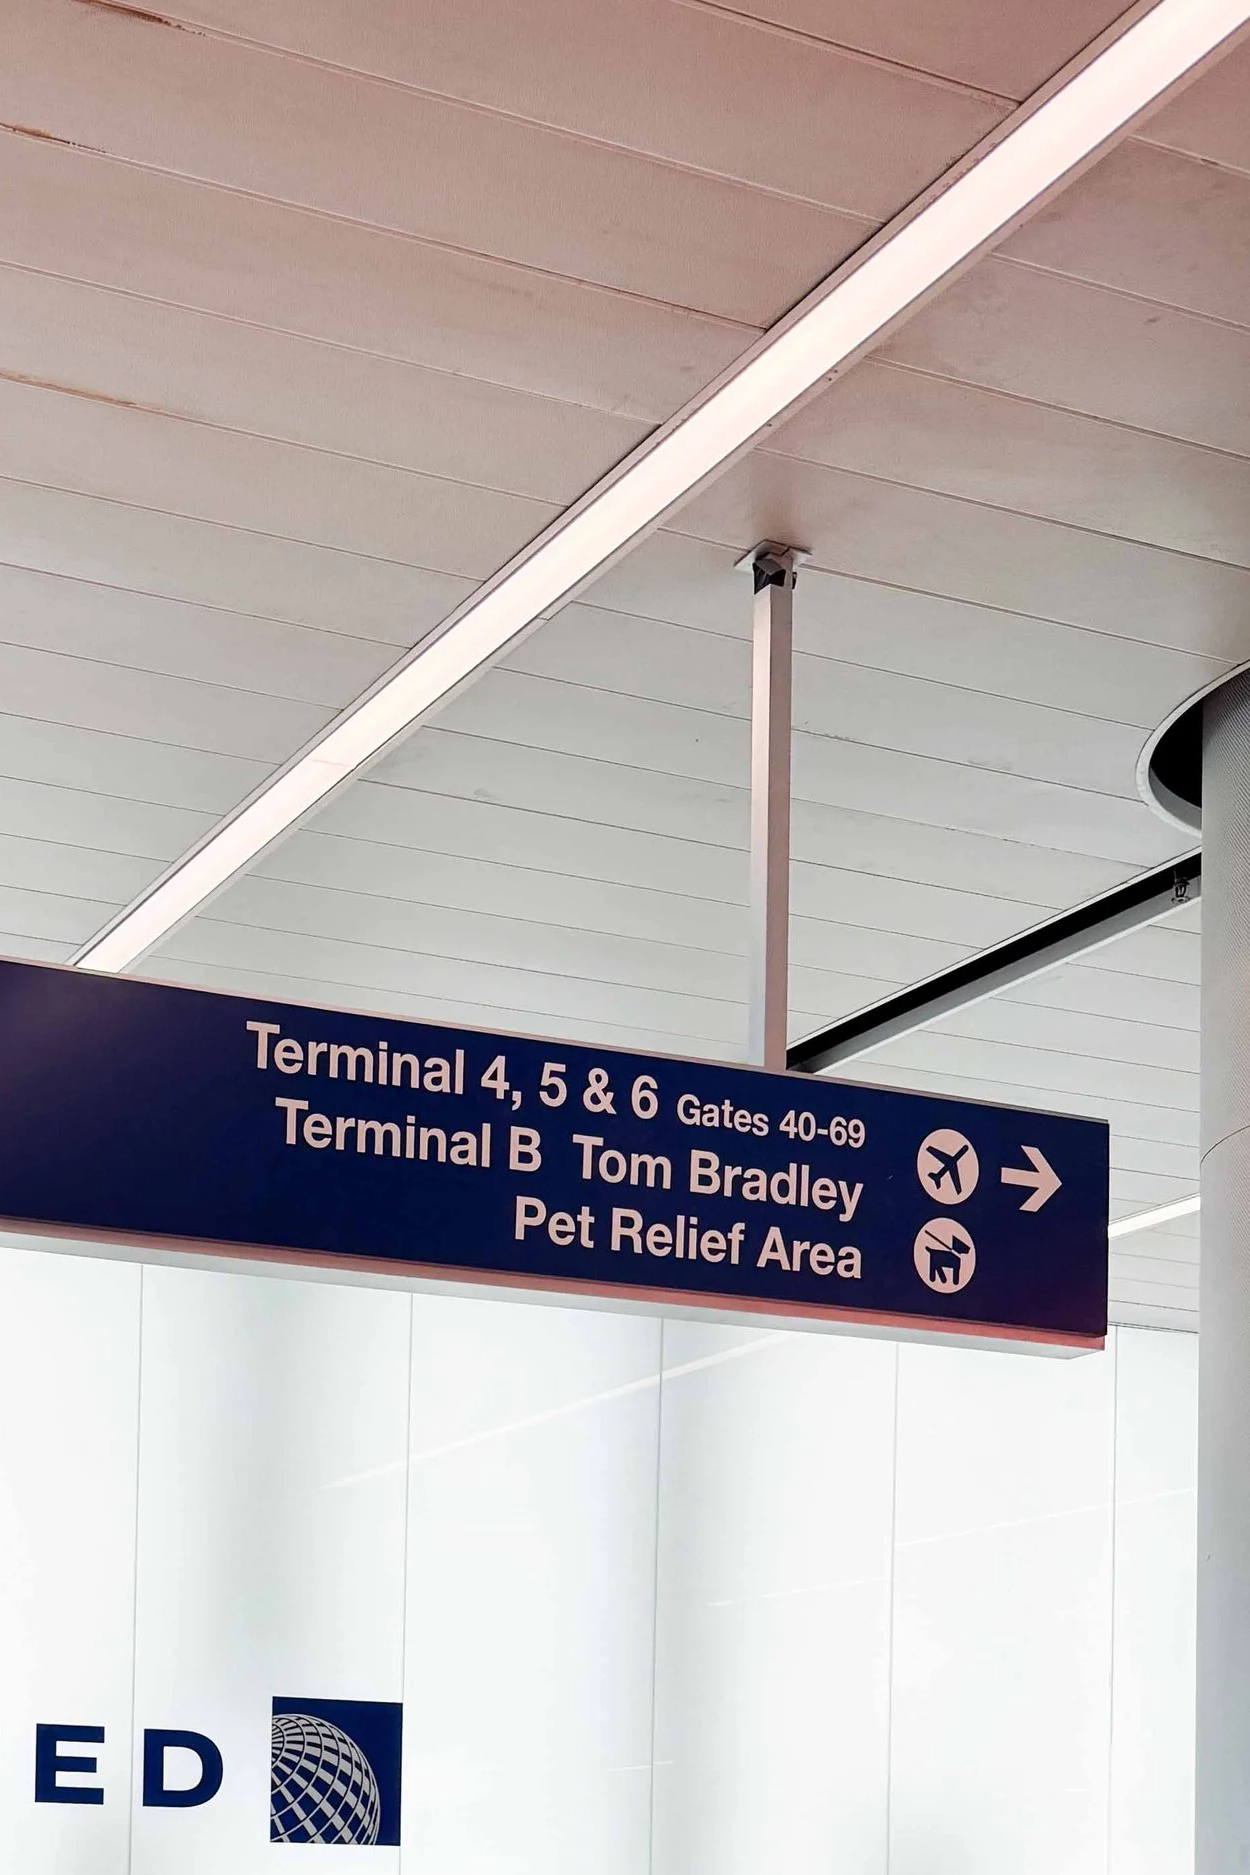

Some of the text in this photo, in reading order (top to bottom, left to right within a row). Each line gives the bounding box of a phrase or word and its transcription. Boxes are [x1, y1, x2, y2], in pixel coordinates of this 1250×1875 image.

[246, 1020, 866, 1149] Terminal 4, 5 & 6 Gates 40-69
[275, 1096, 864, 1223] Terminal B Tom Bradley
[514, 1195, 862, 1279] Pet Relief Area
